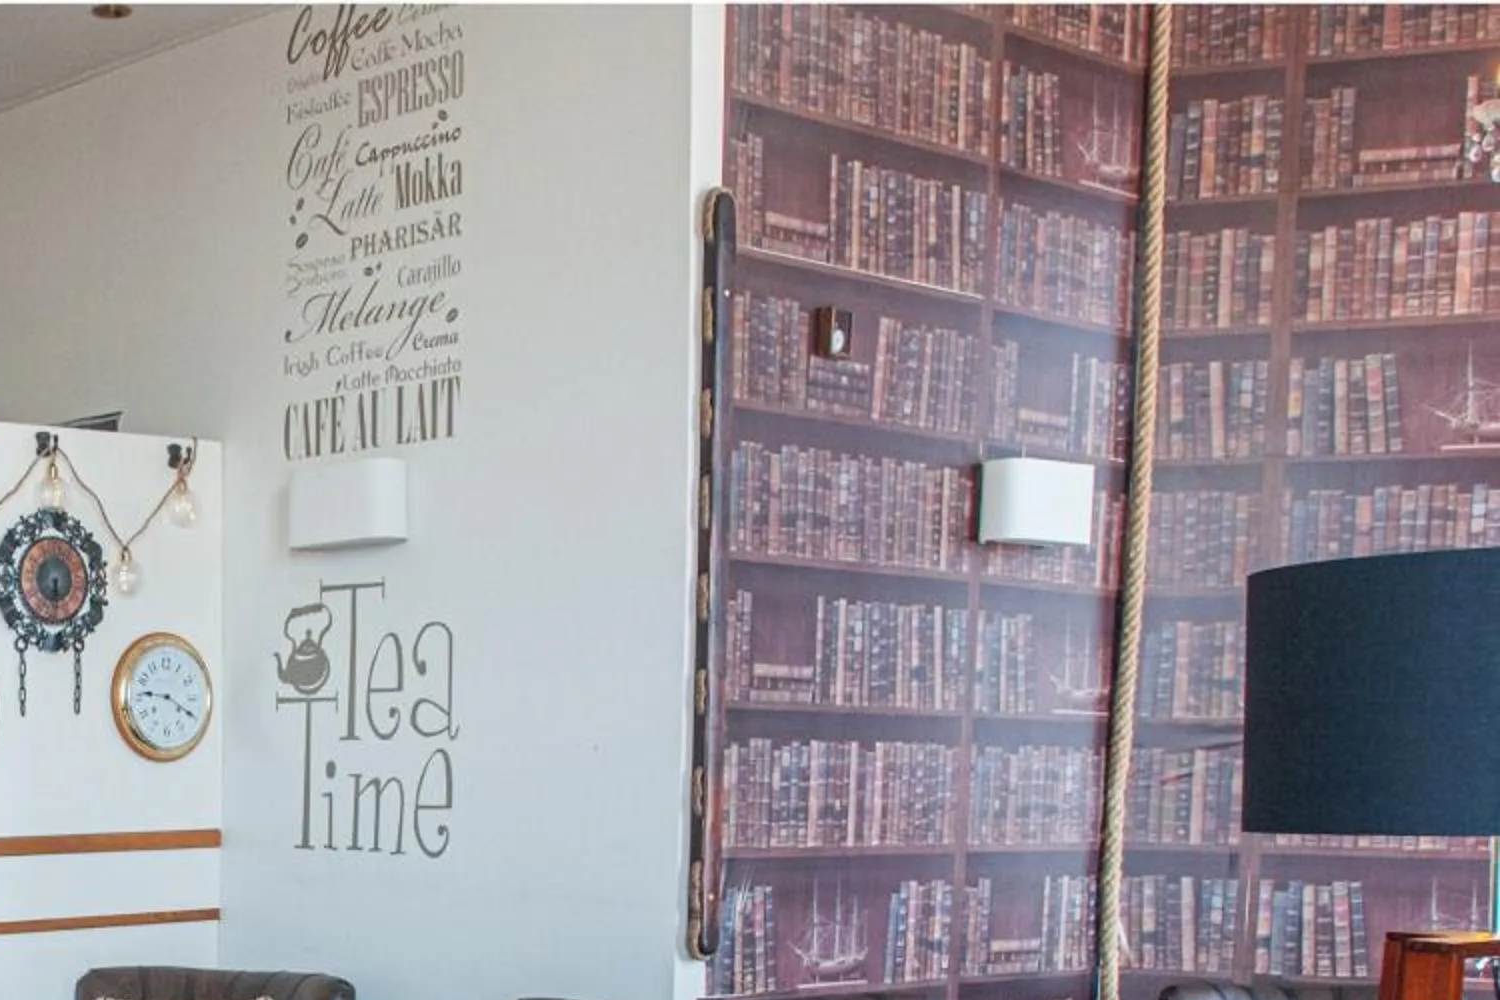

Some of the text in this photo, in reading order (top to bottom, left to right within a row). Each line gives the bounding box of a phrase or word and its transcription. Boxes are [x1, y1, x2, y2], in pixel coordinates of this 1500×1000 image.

[287, 4, 393, 81] Coffee
[358, 50, 465, 129] ESPRESSO
[355, 121, 462, 178] Cappuccino
[396, 152, 463, 211] Mokka
[284, 279, 447, 362] Melange
[284, 341, 384, 377] Irish Coffee
[385, 355, 462, 385] Macchiato
[395, 375, 461, 445] LAIT
[318, 576, 460, 741] Tea
[275, 691, 453, 859] Time
